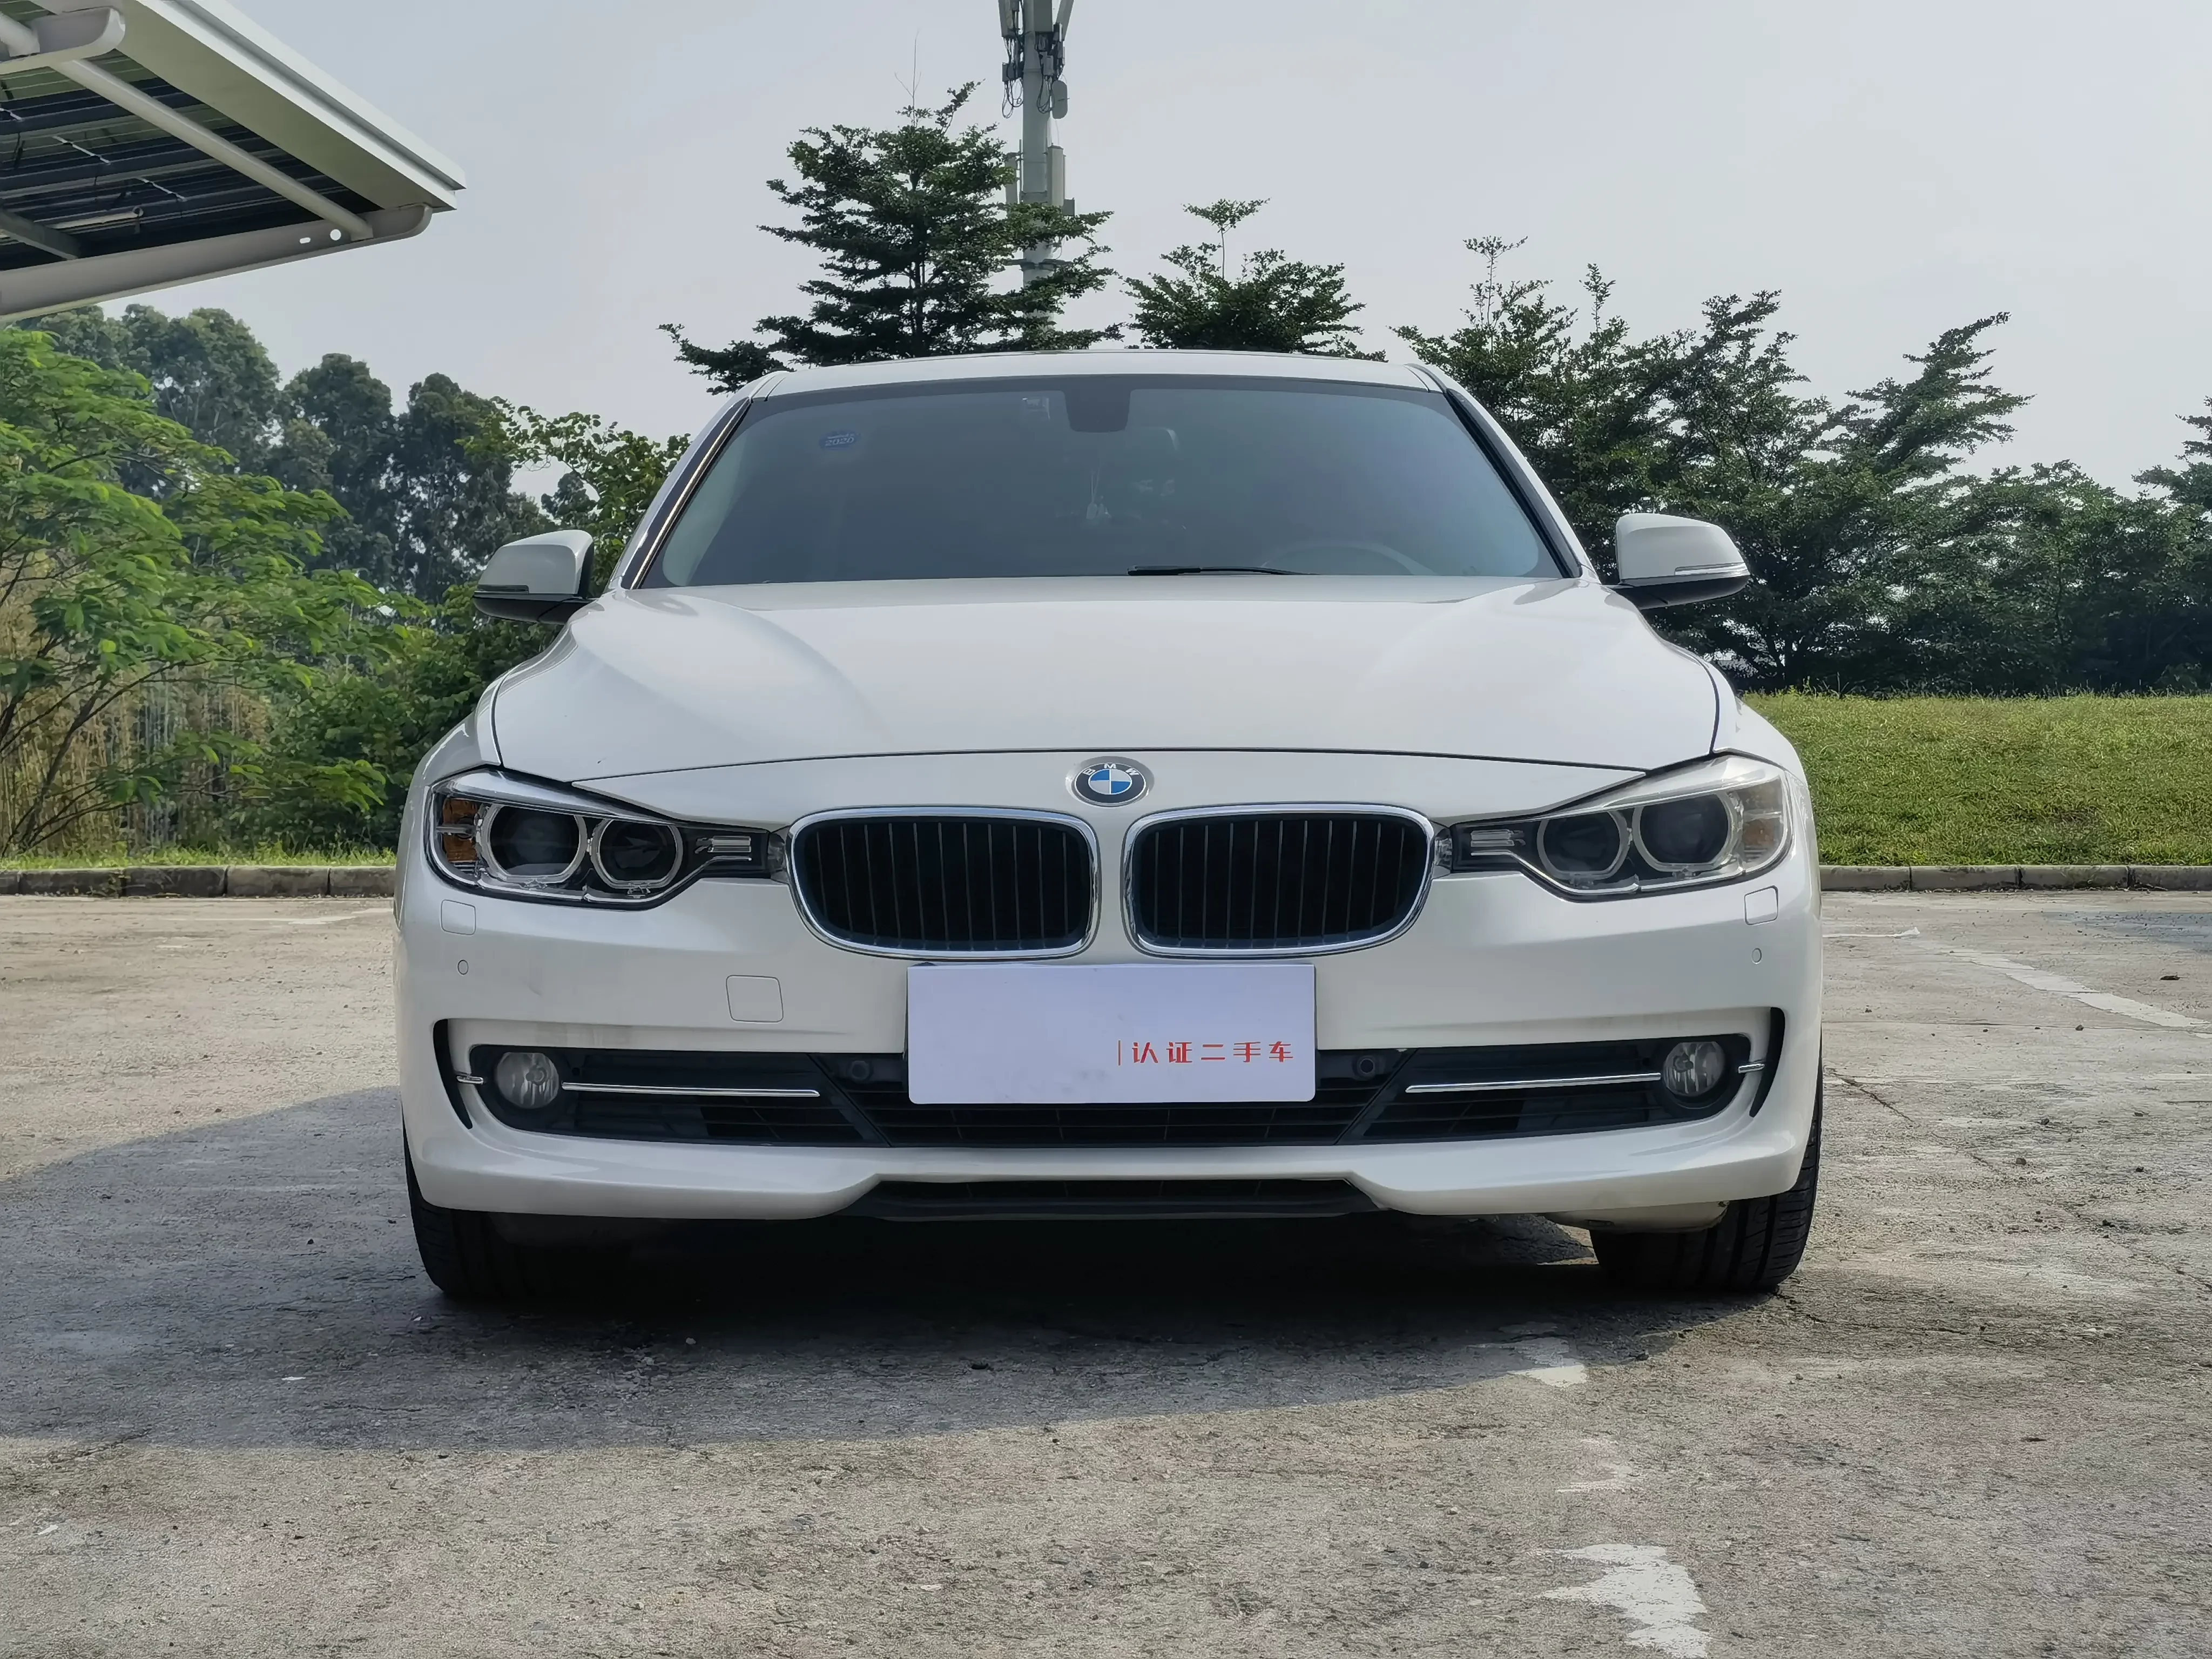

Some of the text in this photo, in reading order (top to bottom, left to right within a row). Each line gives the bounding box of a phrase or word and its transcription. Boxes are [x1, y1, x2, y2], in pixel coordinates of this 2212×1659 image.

[1082, 763, 1139, 776] BMW
[1132, 1041, 1293, 1063] 认证二手车
